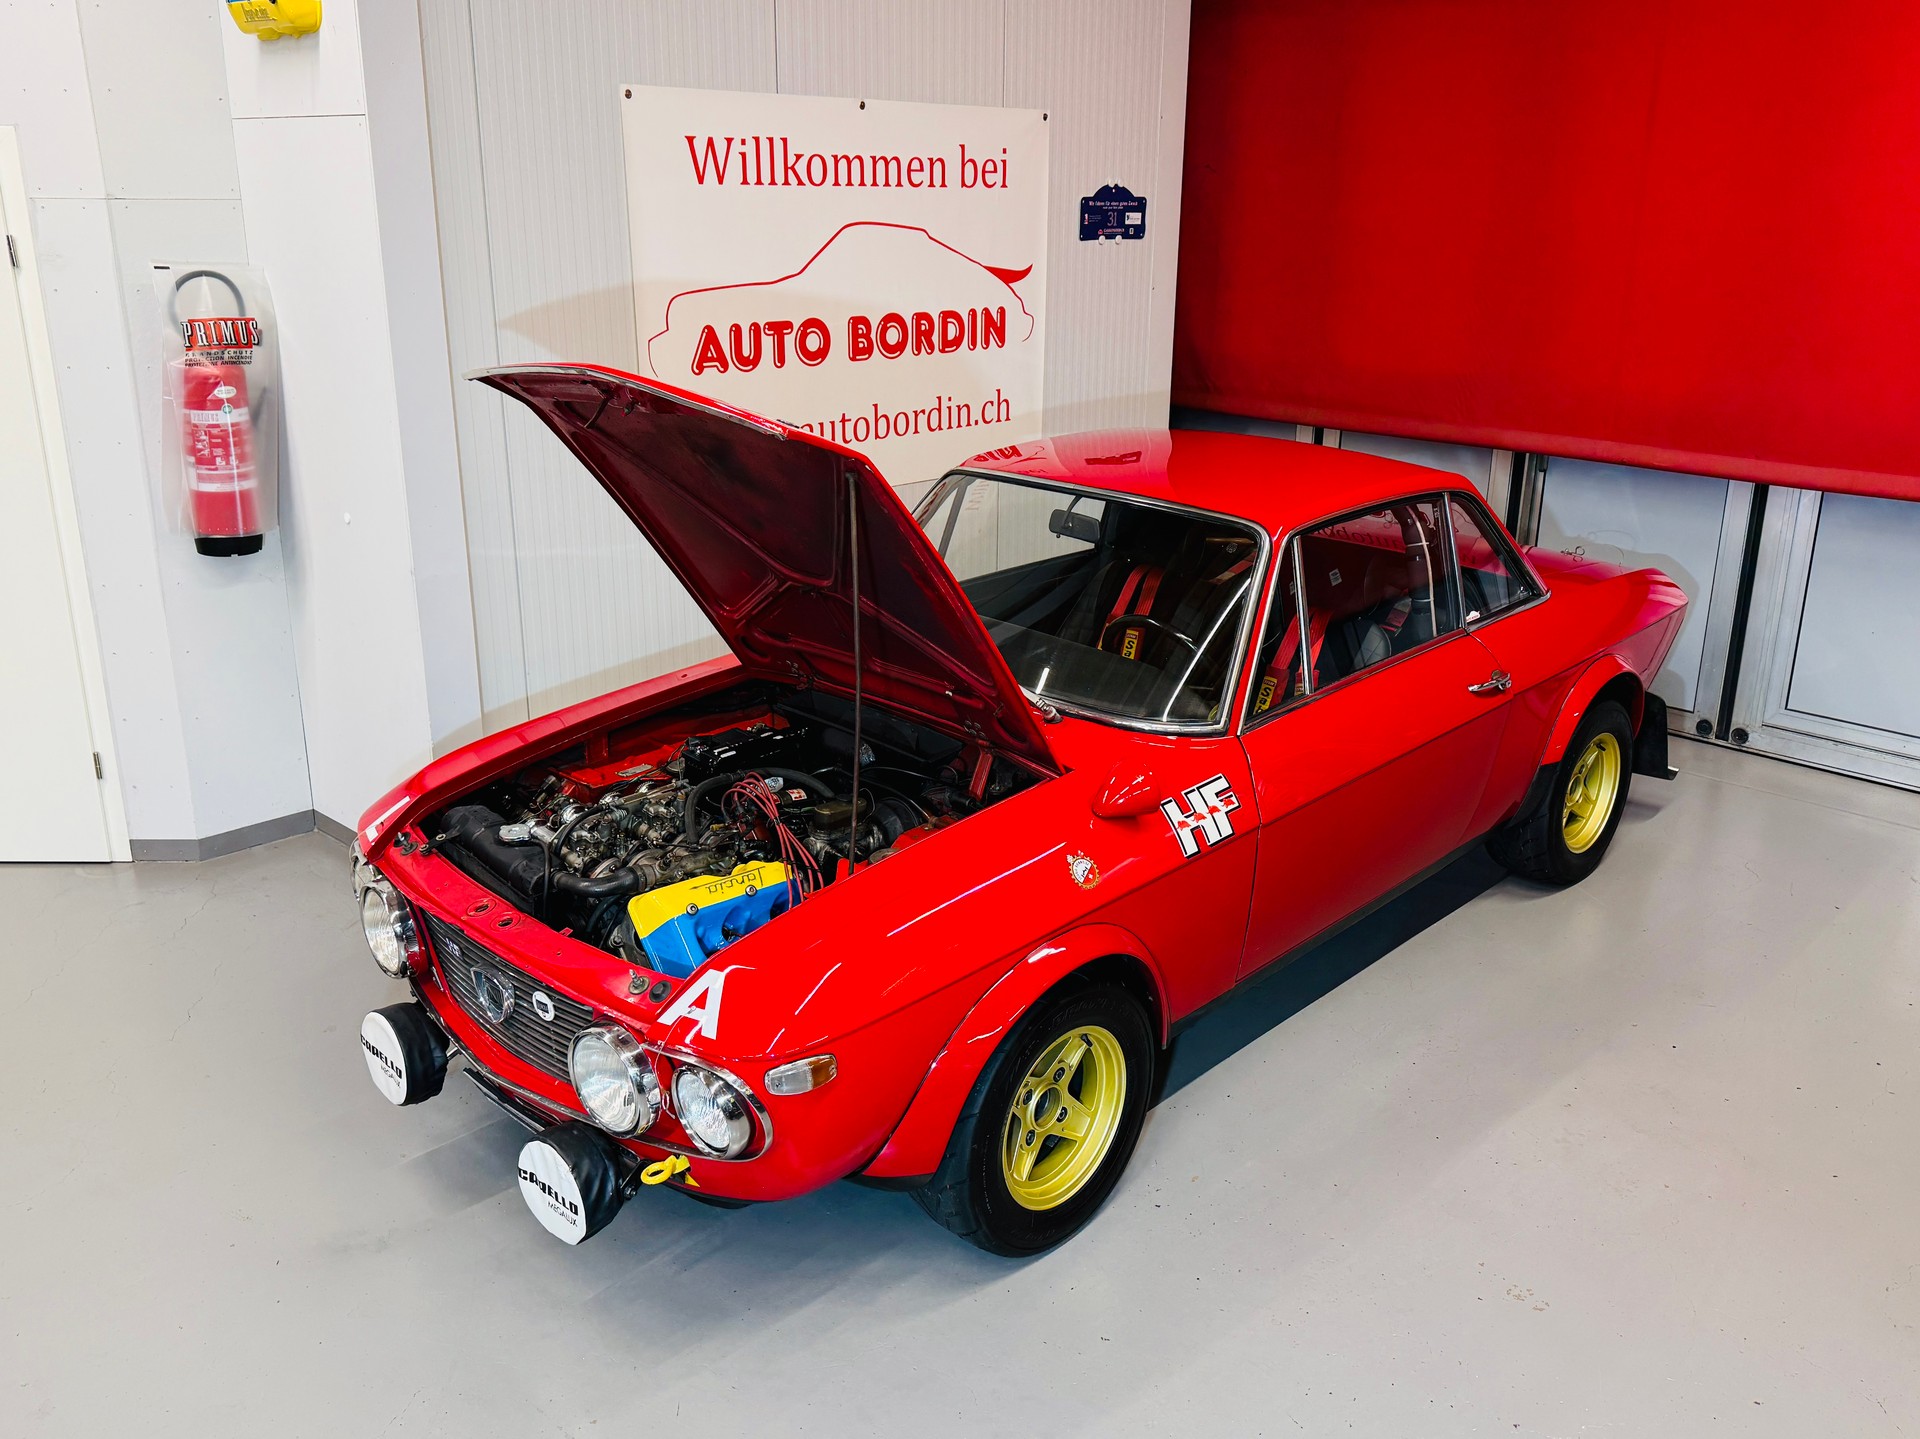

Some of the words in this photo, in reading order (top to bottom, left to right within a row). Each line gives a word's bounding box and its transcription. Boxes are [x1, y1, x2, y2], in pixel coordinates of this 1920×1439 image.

[685, 135, 948, 189] Willkommen
[959, 144, 1009, 189] bei
[1107, 211, 1117, 227] 31
[180, 319, 261, 348] PRIMUS
[690, 316, 832, 376] AUTO
[847, 305, 1007, 363] BORDIN
[1159, 772, 1242, 860] HF
[700, 865, 767, 895] Lancia
[656, 968, 726, 1041] A
[359, 1034, 403, 1080] CARELLO
[547, 1201, 578, 1228] MEGALUX
